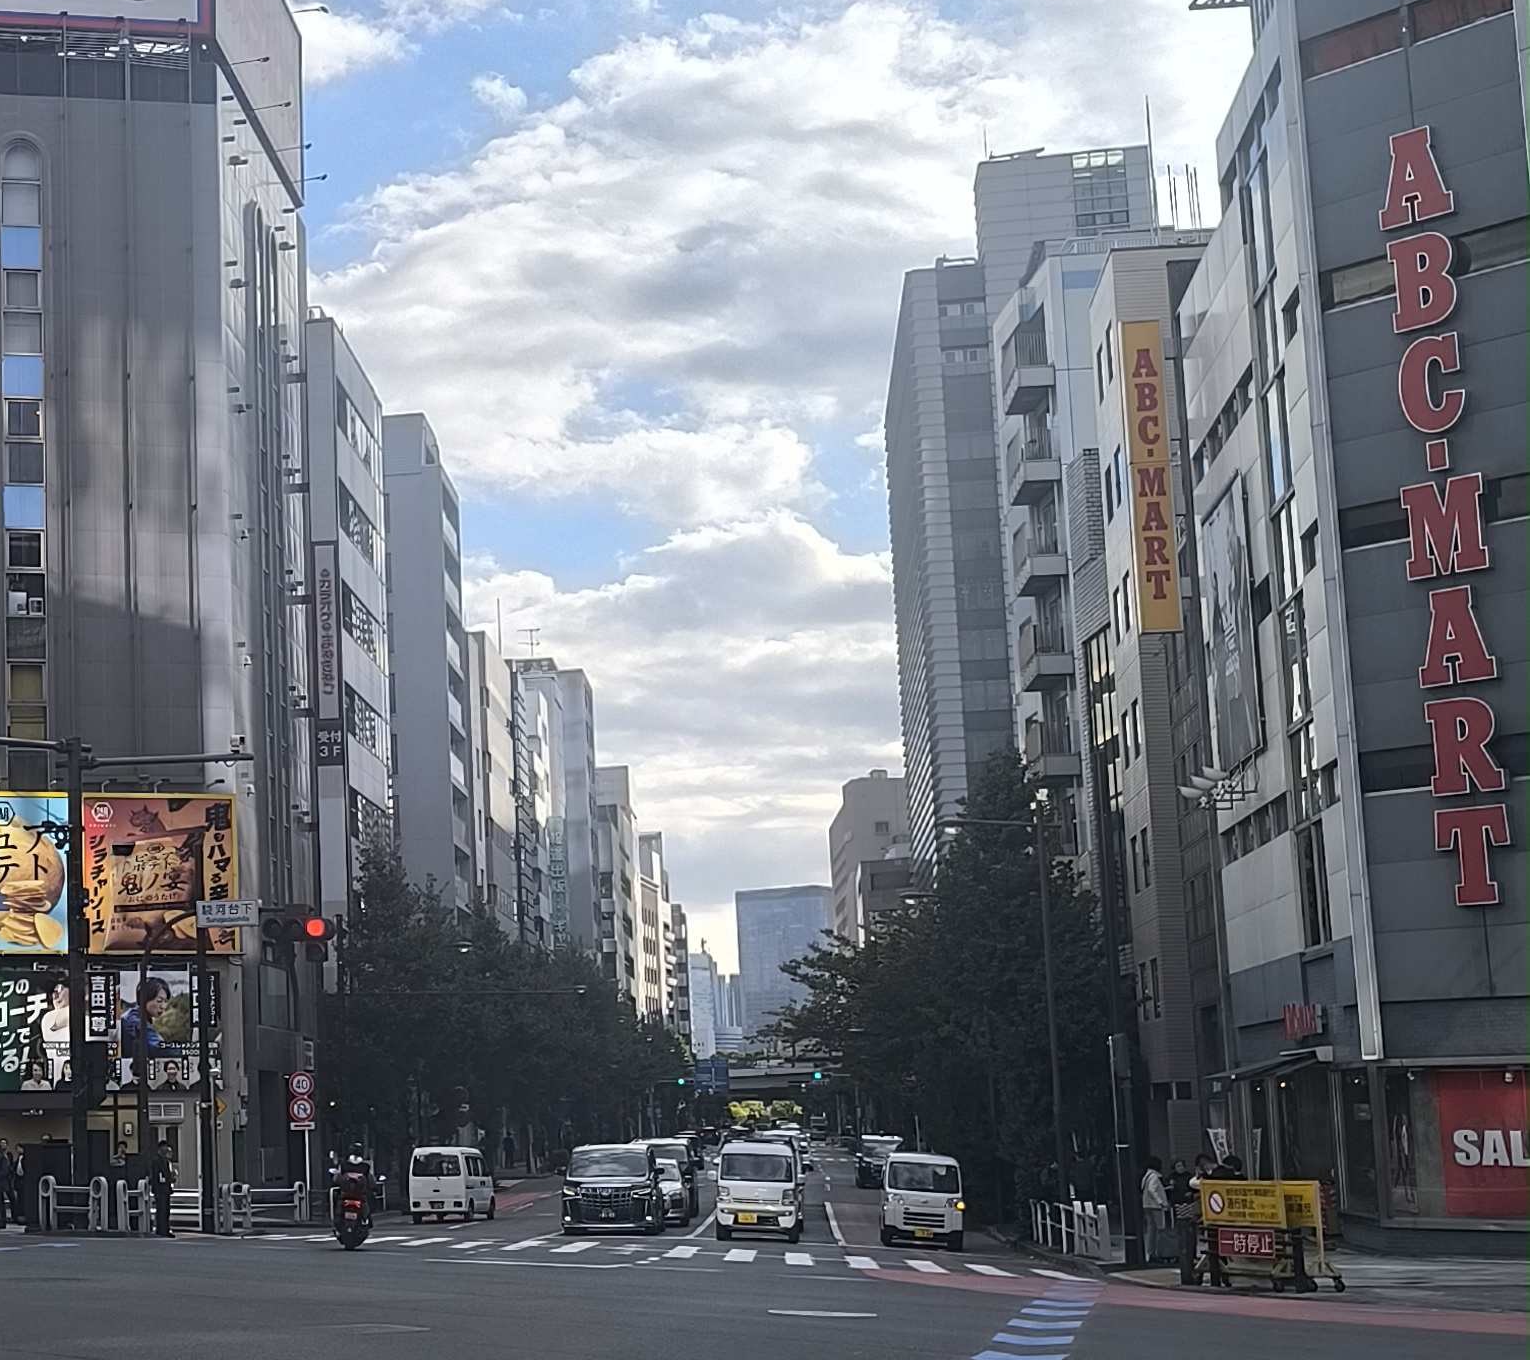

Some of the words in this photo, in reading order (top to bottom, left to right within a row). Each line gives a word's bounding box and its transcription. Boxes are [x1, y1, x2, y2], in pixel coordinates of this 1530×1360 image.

[1131, 348, 1172, 601] ABC-MART
[1379, 124, 1512, 907] ABC-MART
[317, 730, 342, 743] 受付
[320, 745, 342, 757] 3F
[89, 834, 109, 935] シラチャーソース
[201, 903, 254, 916] 駿河台下
[294, 1079, 308, 1091] 40
[1452, 1128, 1530, 1168] SAL
[1221, 1233, 1274, 1254] 一時停止
